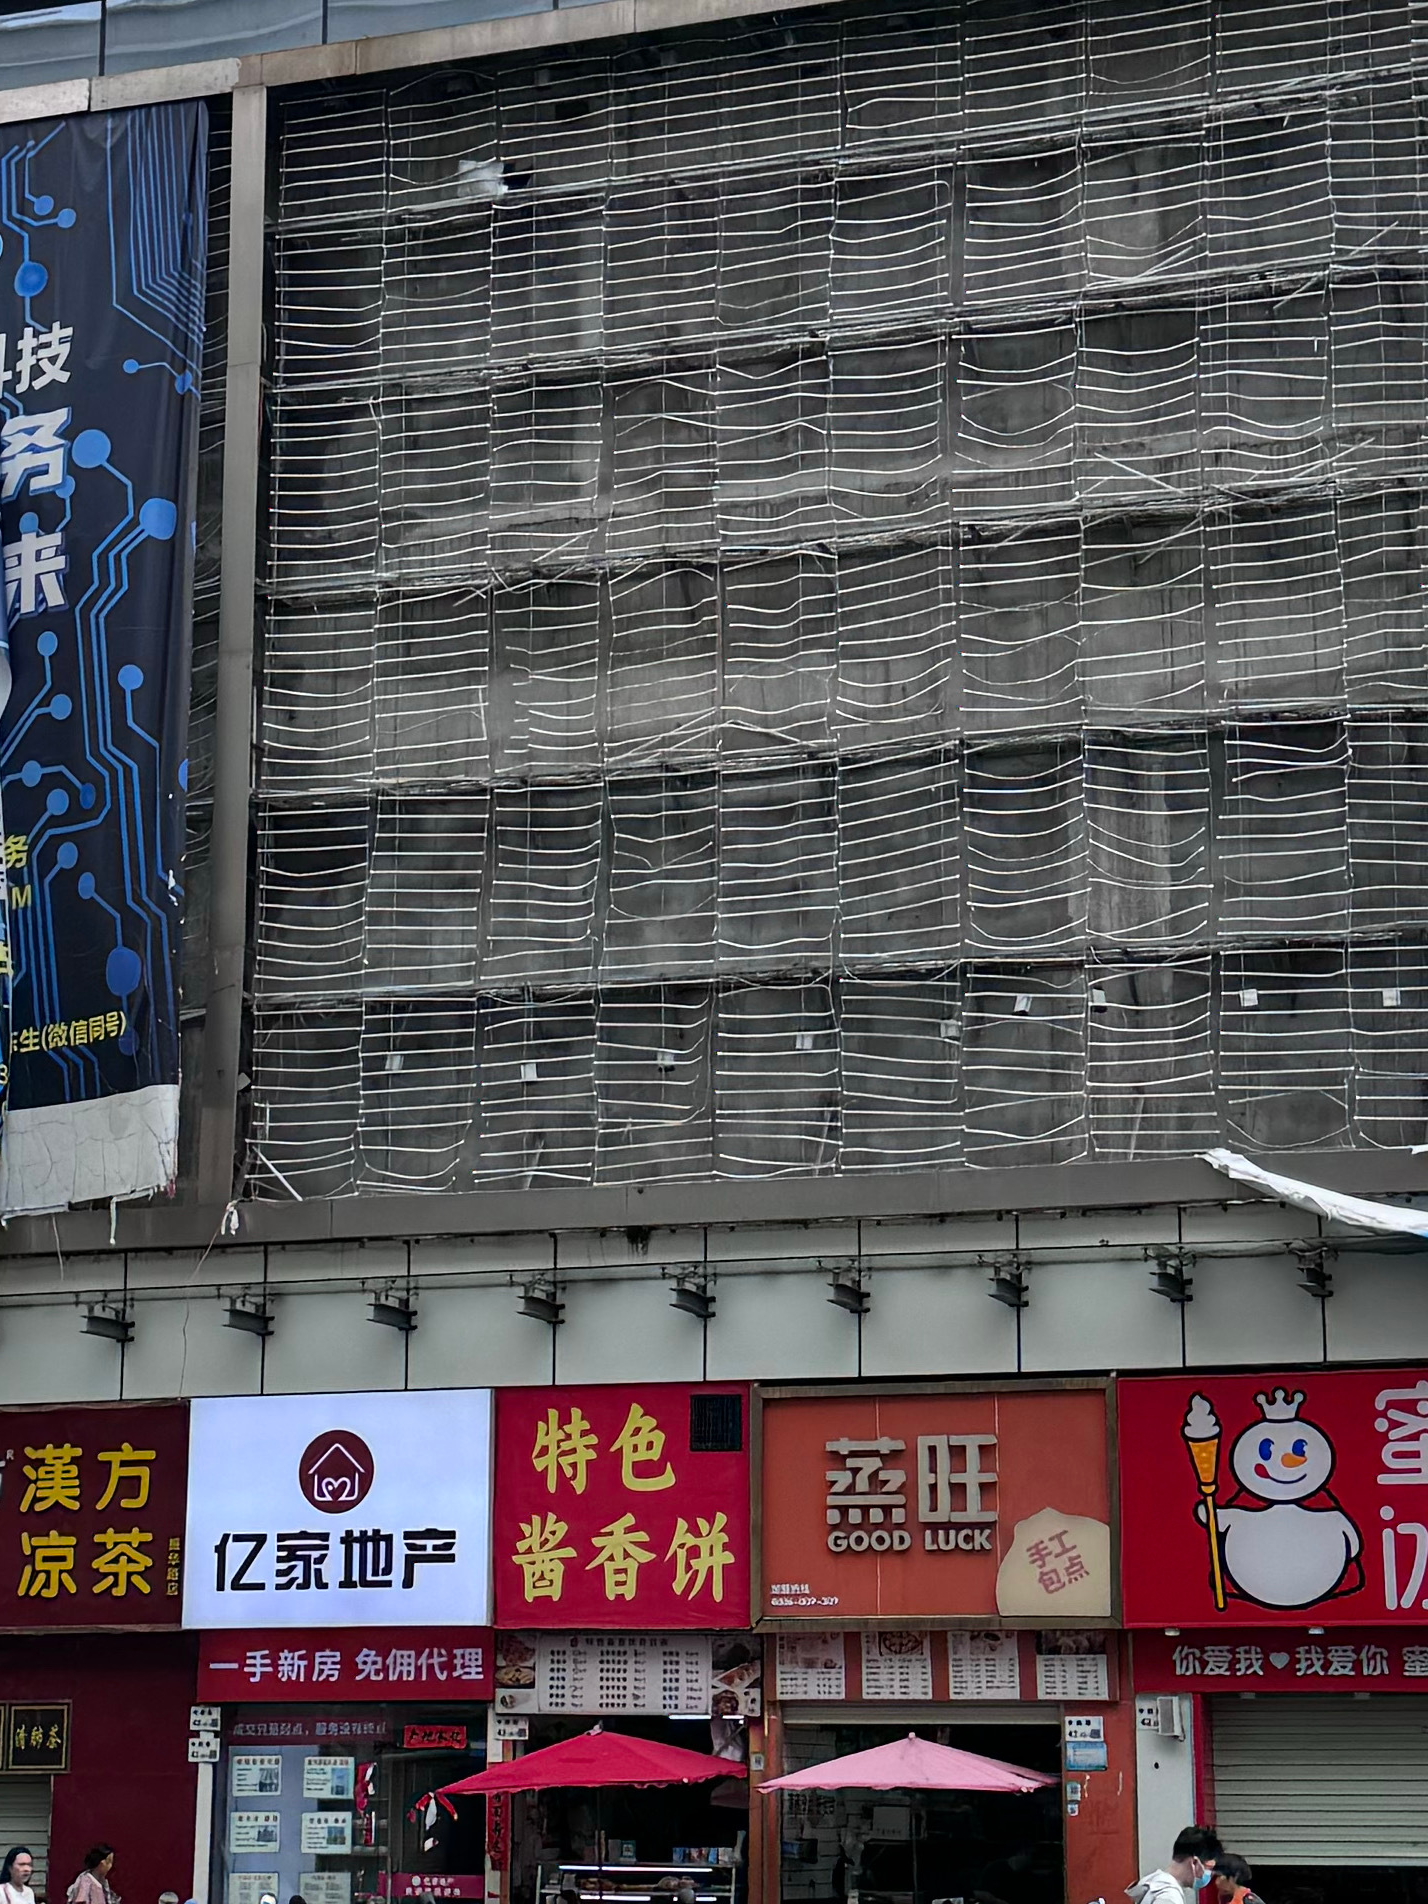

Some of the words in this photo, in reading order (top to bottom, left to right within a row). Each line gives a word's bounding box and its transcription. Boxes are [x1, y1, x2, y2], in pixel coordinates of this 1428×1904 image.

[19, 1442, 157, 1513] 漢方
[530, 1402, 677, 1496] 特色
[824, 1433, 1000, 1525] 蒸旺
[16, 1526, 154, 1599] 凉茶
[213, 1527, 458, 1593] 亿家地产
[511, 1510, 737, 1604] 酱香饼
[826, 1529, 912, 1553] GOOD
[924, 1528, 994, 1552] LUCK
[1025, 1529, 1078, 1571] 手工
[1035, 1553, 1091, 1596] 包点
[208, 1648, 342, 1684] 一手新房
[354, 1647, 485, 1683] 免佣代理
